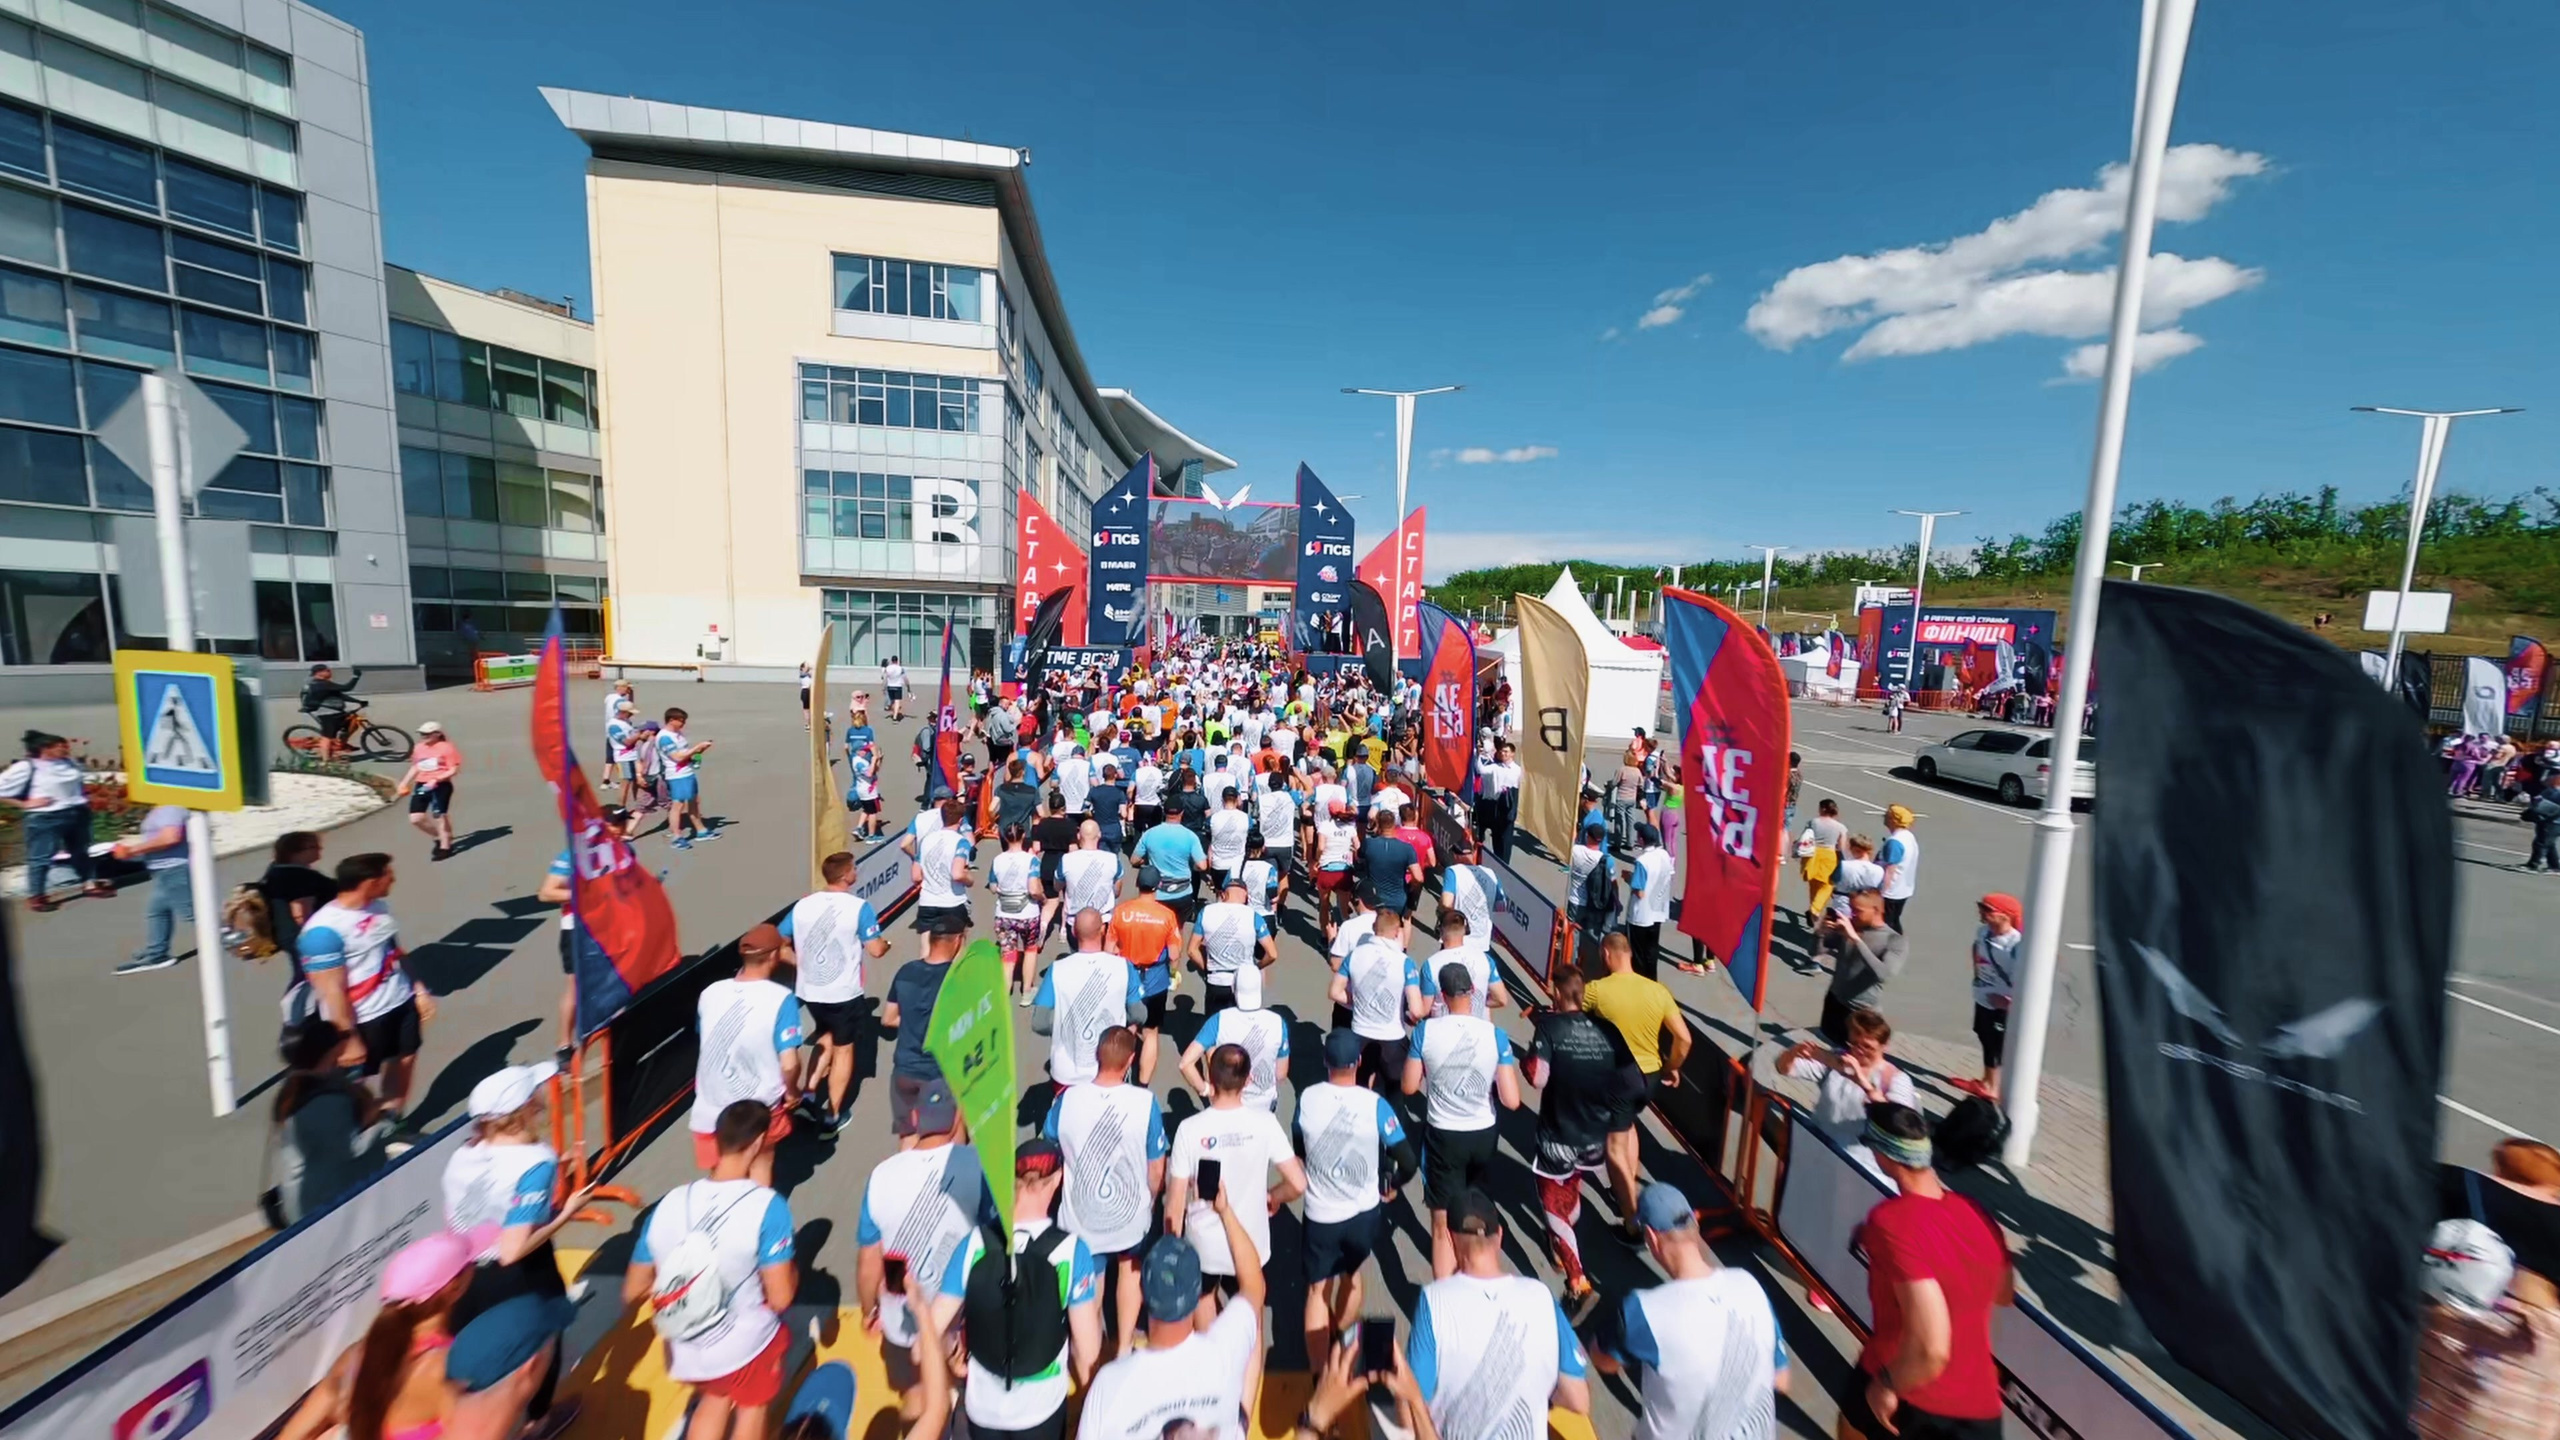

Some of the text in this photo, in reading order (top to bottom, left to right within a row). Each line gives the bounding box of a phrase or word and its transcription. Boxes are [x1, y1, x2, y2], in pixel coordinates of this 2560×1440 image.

[1111, 533, 1141, 545] ПСБ
[1323, 543, 1352, 556] ПСБ
[1022, 515, 1040, 621] СТАР
[1402, 532, 1419, 647] СТАРТ
[1506, 899, 1530, 932] AER
